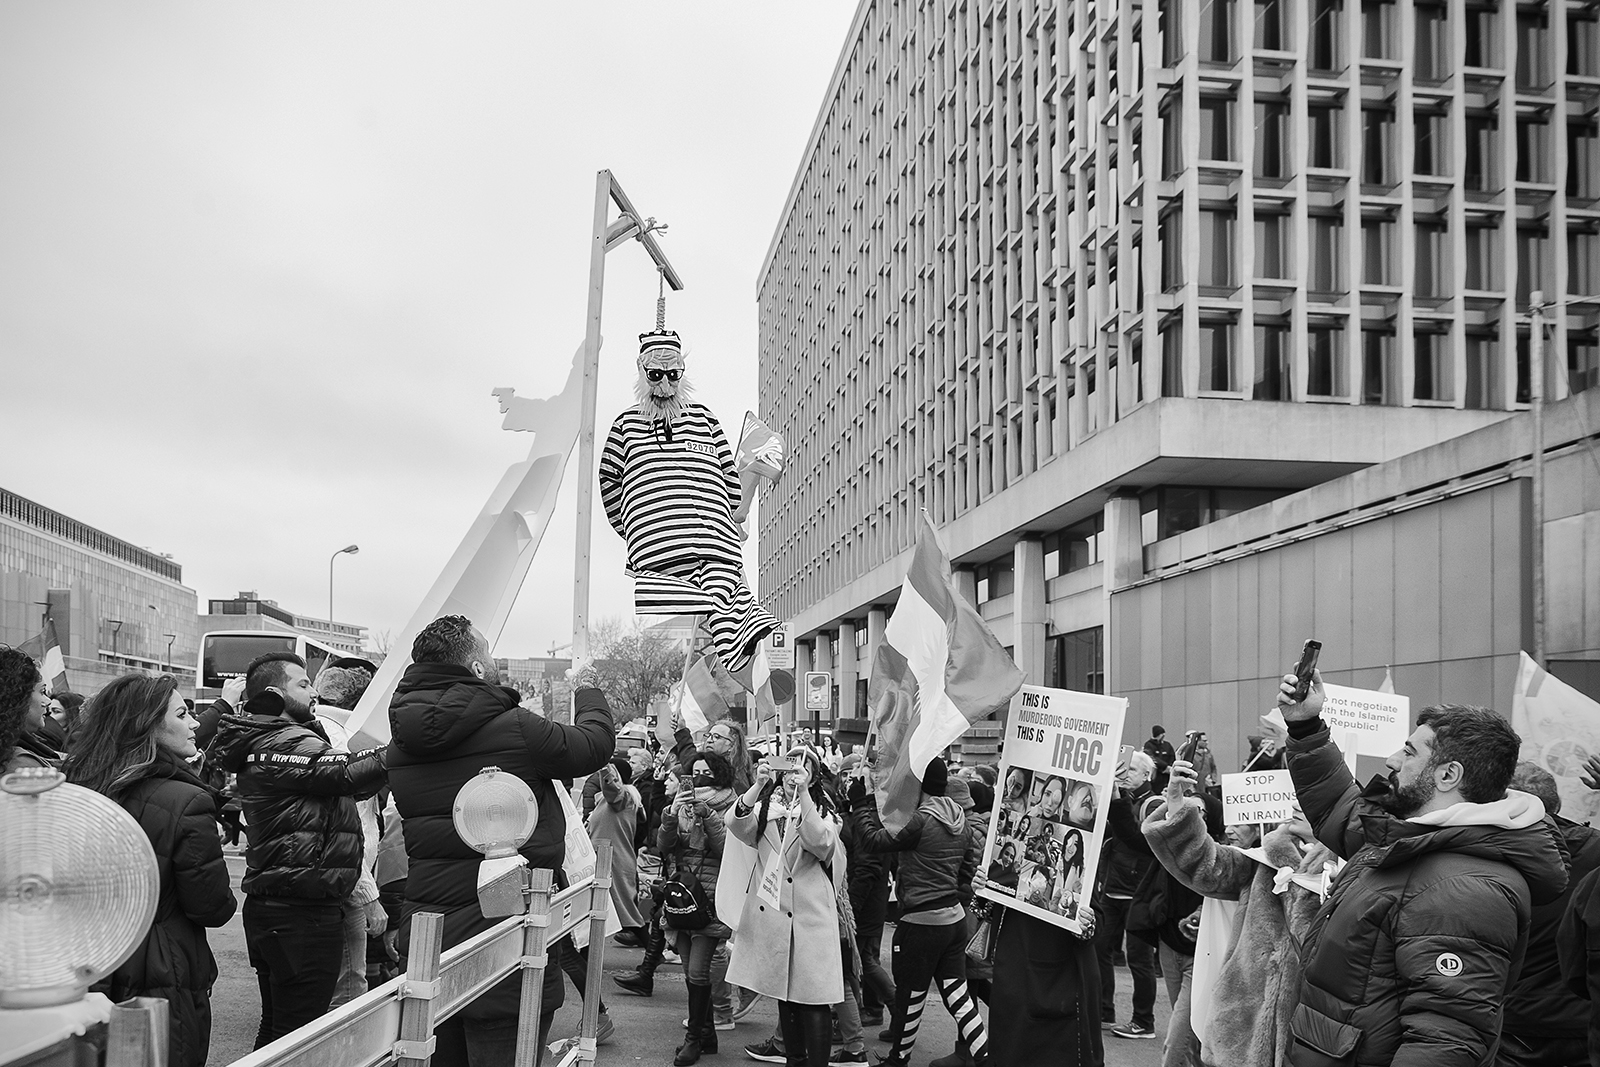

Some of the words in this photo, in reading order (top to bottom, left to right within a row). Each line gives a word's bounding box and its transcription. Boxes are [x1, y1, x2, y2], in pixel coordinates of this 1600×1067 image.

[1022, 692, 1040, 708] THIS
[1041, 695, 1050, 709] IS
[1331, 698, 1347, 706] not
[1350, 700, 1398, 713] negotiate
[1018, 709, 1062, 728] MURDEROUS
[1064, 717, 1110, 736] GOVERMENT
[1340, 709, 1355, 717] the
[1359, 711, 1395, 723] Islamic
[1330, 717, 1379, 731] Republic!
[1016, 725, 1034, 741] THIS
[1036, 729, 1045, 743] IS
[1051, 733, 1104, 776] IRGC
[1245, 775, 1275, 785] STOP
[1225, 792, 1297, 804] EXECUTIONS
[1238, 812, 1249, 821] IN
[1253, 809, 1286, 820] IRAN!
